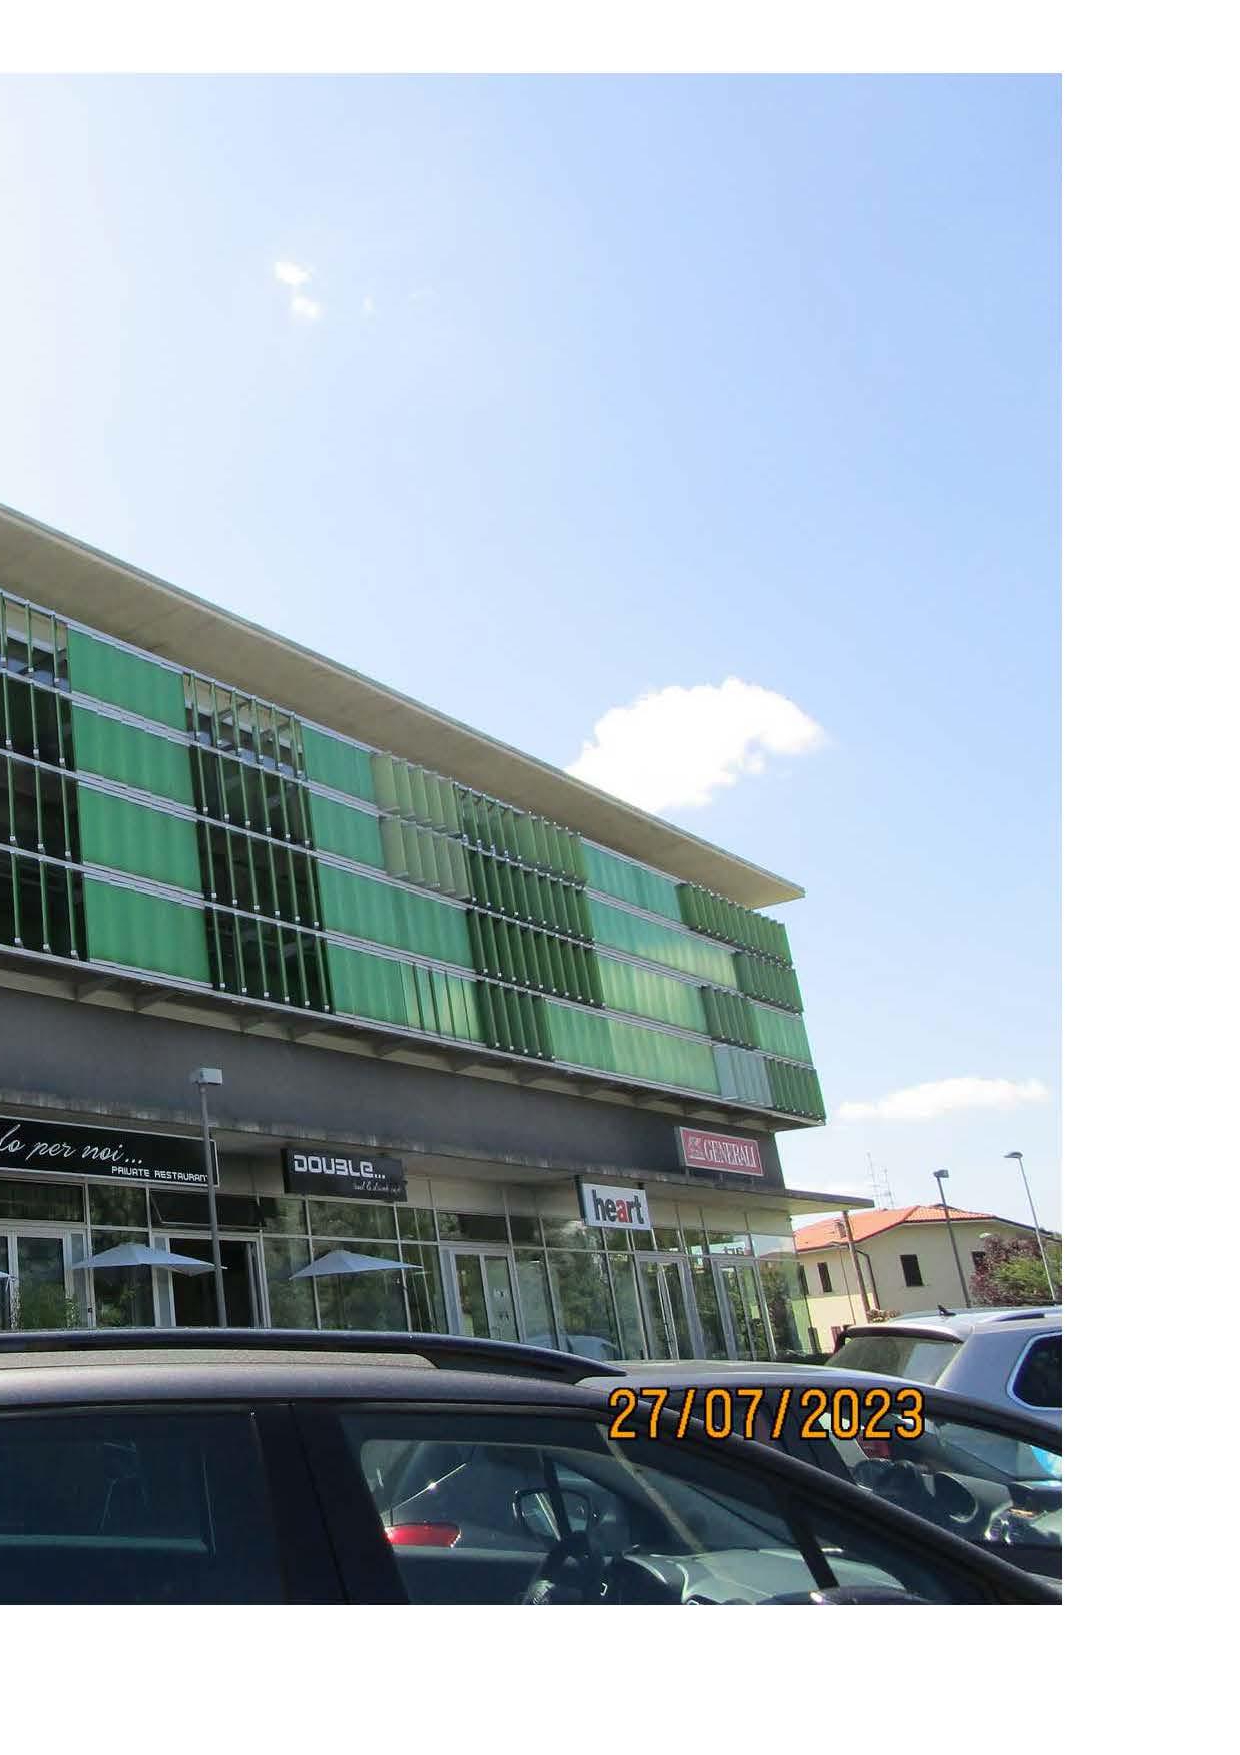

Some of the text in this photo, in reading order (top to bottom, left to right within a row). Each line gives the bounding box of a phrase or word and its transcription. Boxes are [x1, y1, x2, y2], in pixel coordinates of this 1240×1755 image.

[25, 1140, 75, 1161] per
[703, 1138, 757, 1168] GENERALI
[592, 1189, 644, 1224] heart
